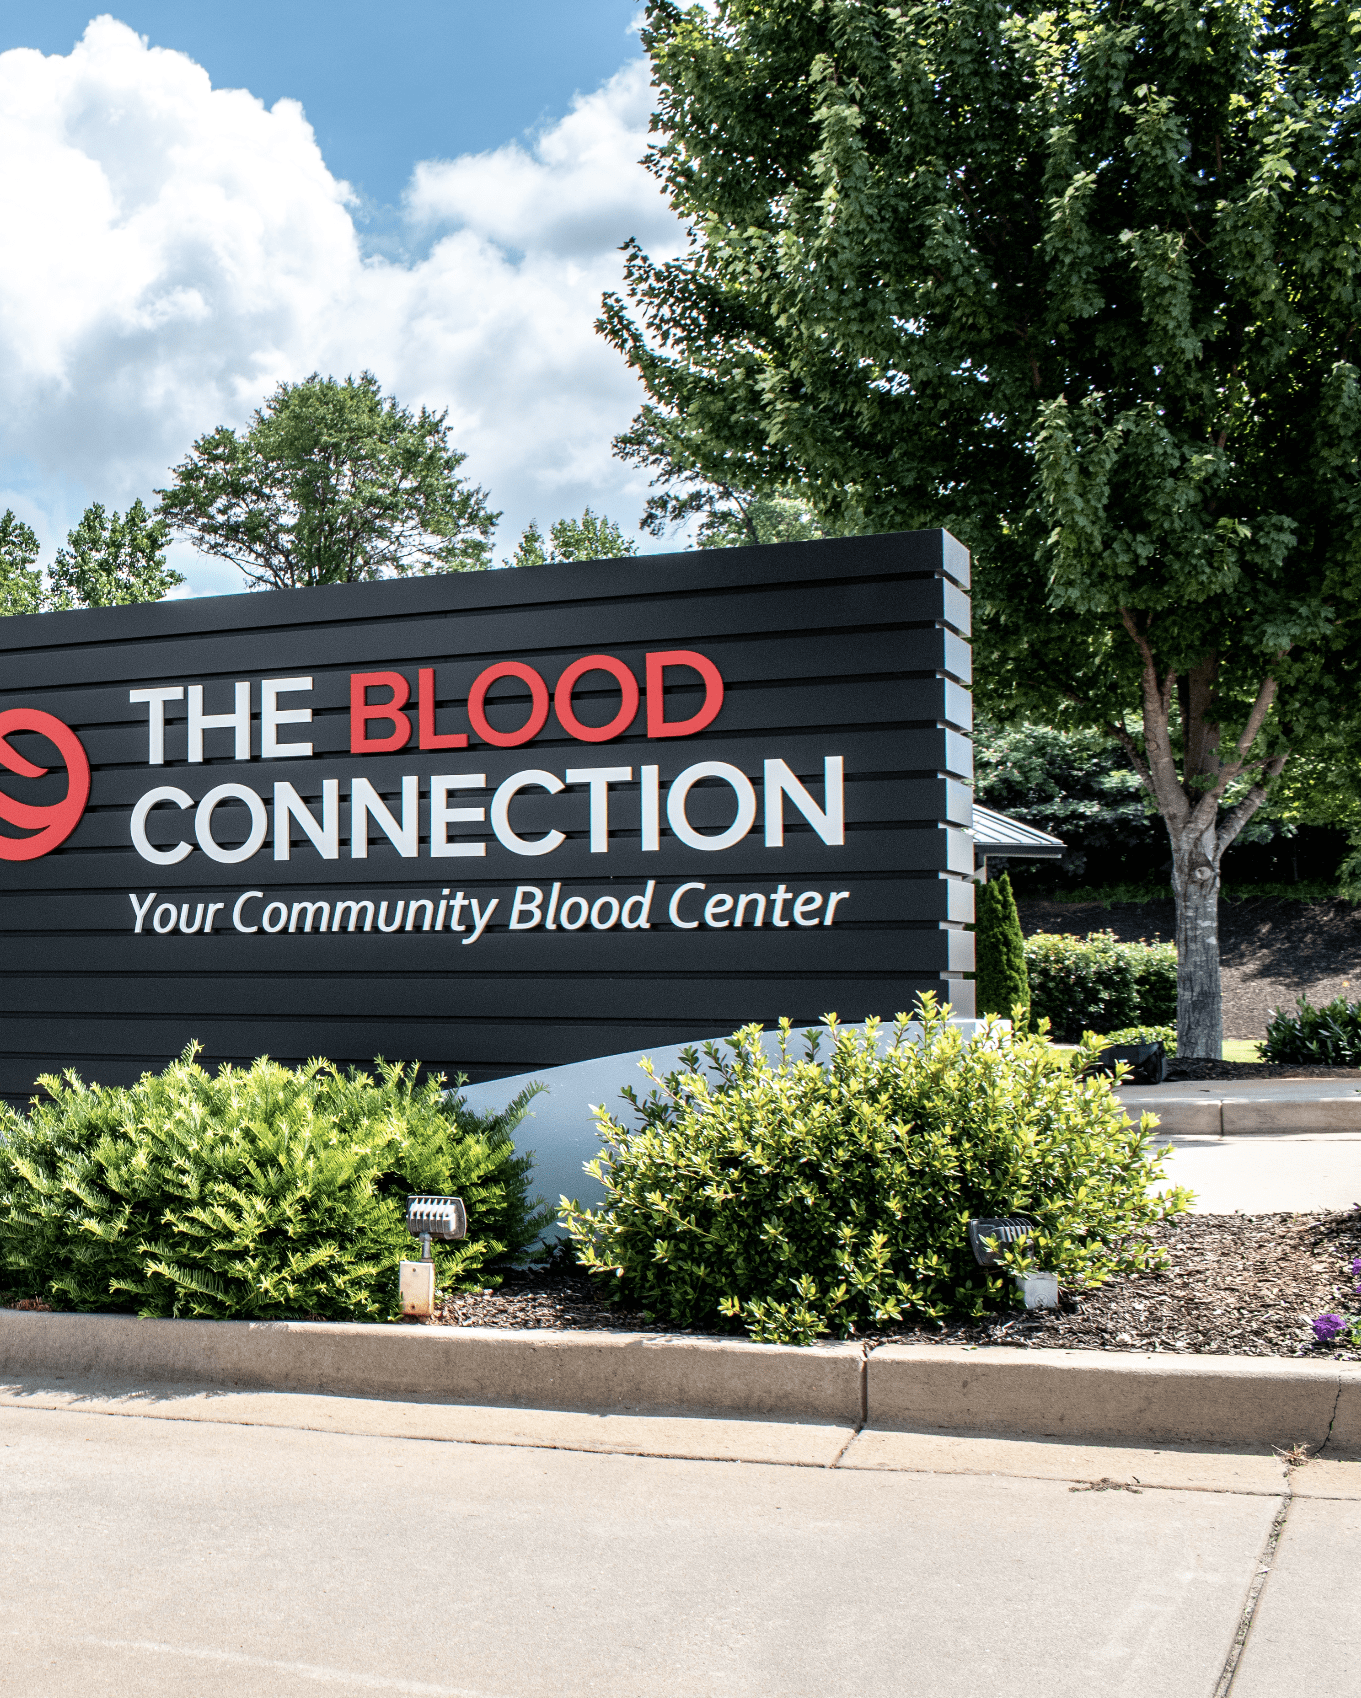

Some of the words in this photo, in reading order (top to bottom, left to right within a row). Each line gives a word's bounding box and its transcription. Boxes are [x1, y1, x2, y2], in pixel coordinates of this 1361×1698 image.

[129, 676, 314, 765] THE
[349, 649, 725, 754] BLOOD
[130, 755, 845, 866] CONNECTION
[128, 891, 225, 934] Your
[232, 888, 501, 945] Community
[509, 879, 657, 931] Blood
[669, 881, 851, 929] Center
